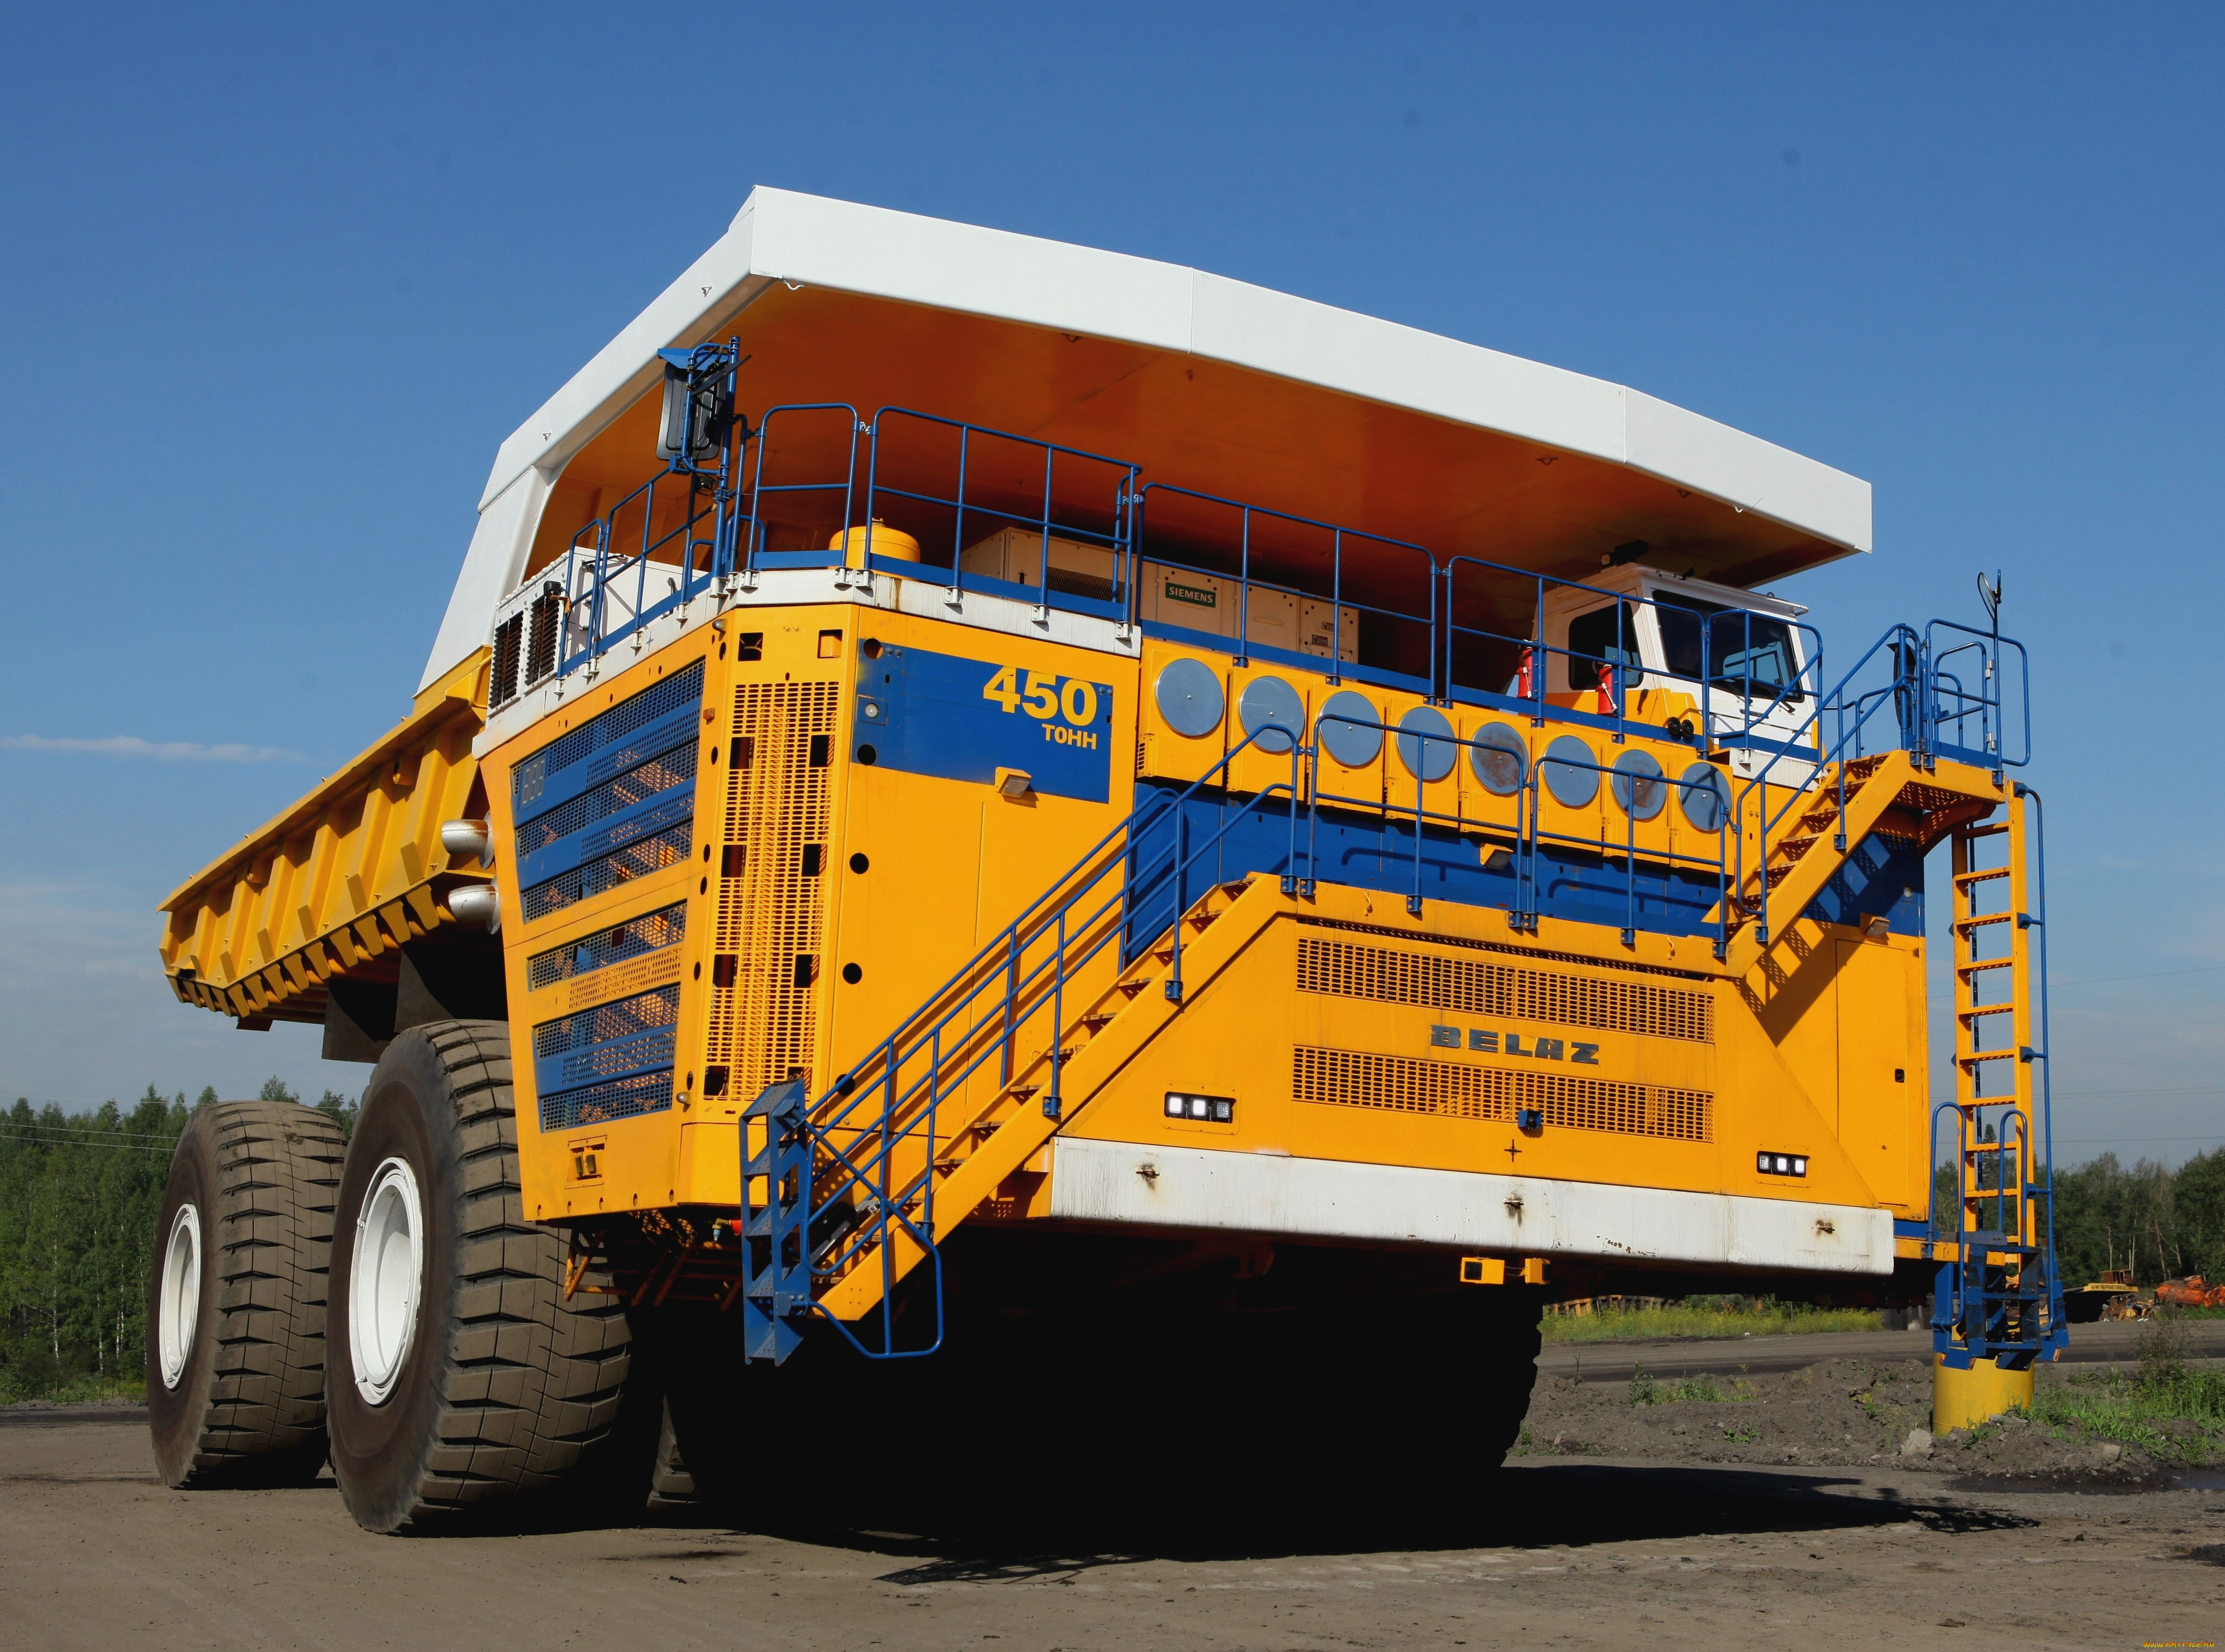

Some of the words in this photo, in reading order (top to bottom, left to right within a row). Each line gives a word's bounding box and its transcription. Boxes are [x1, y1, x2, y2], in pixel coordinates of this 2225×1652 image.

[1169, 587, 1212, 603] SIEMENS
[983, 665, 1097, 726] 450
[1042, 724, 1097, 750] ТОНН
[1431, 1025, 1599, 1065] BELAZ
